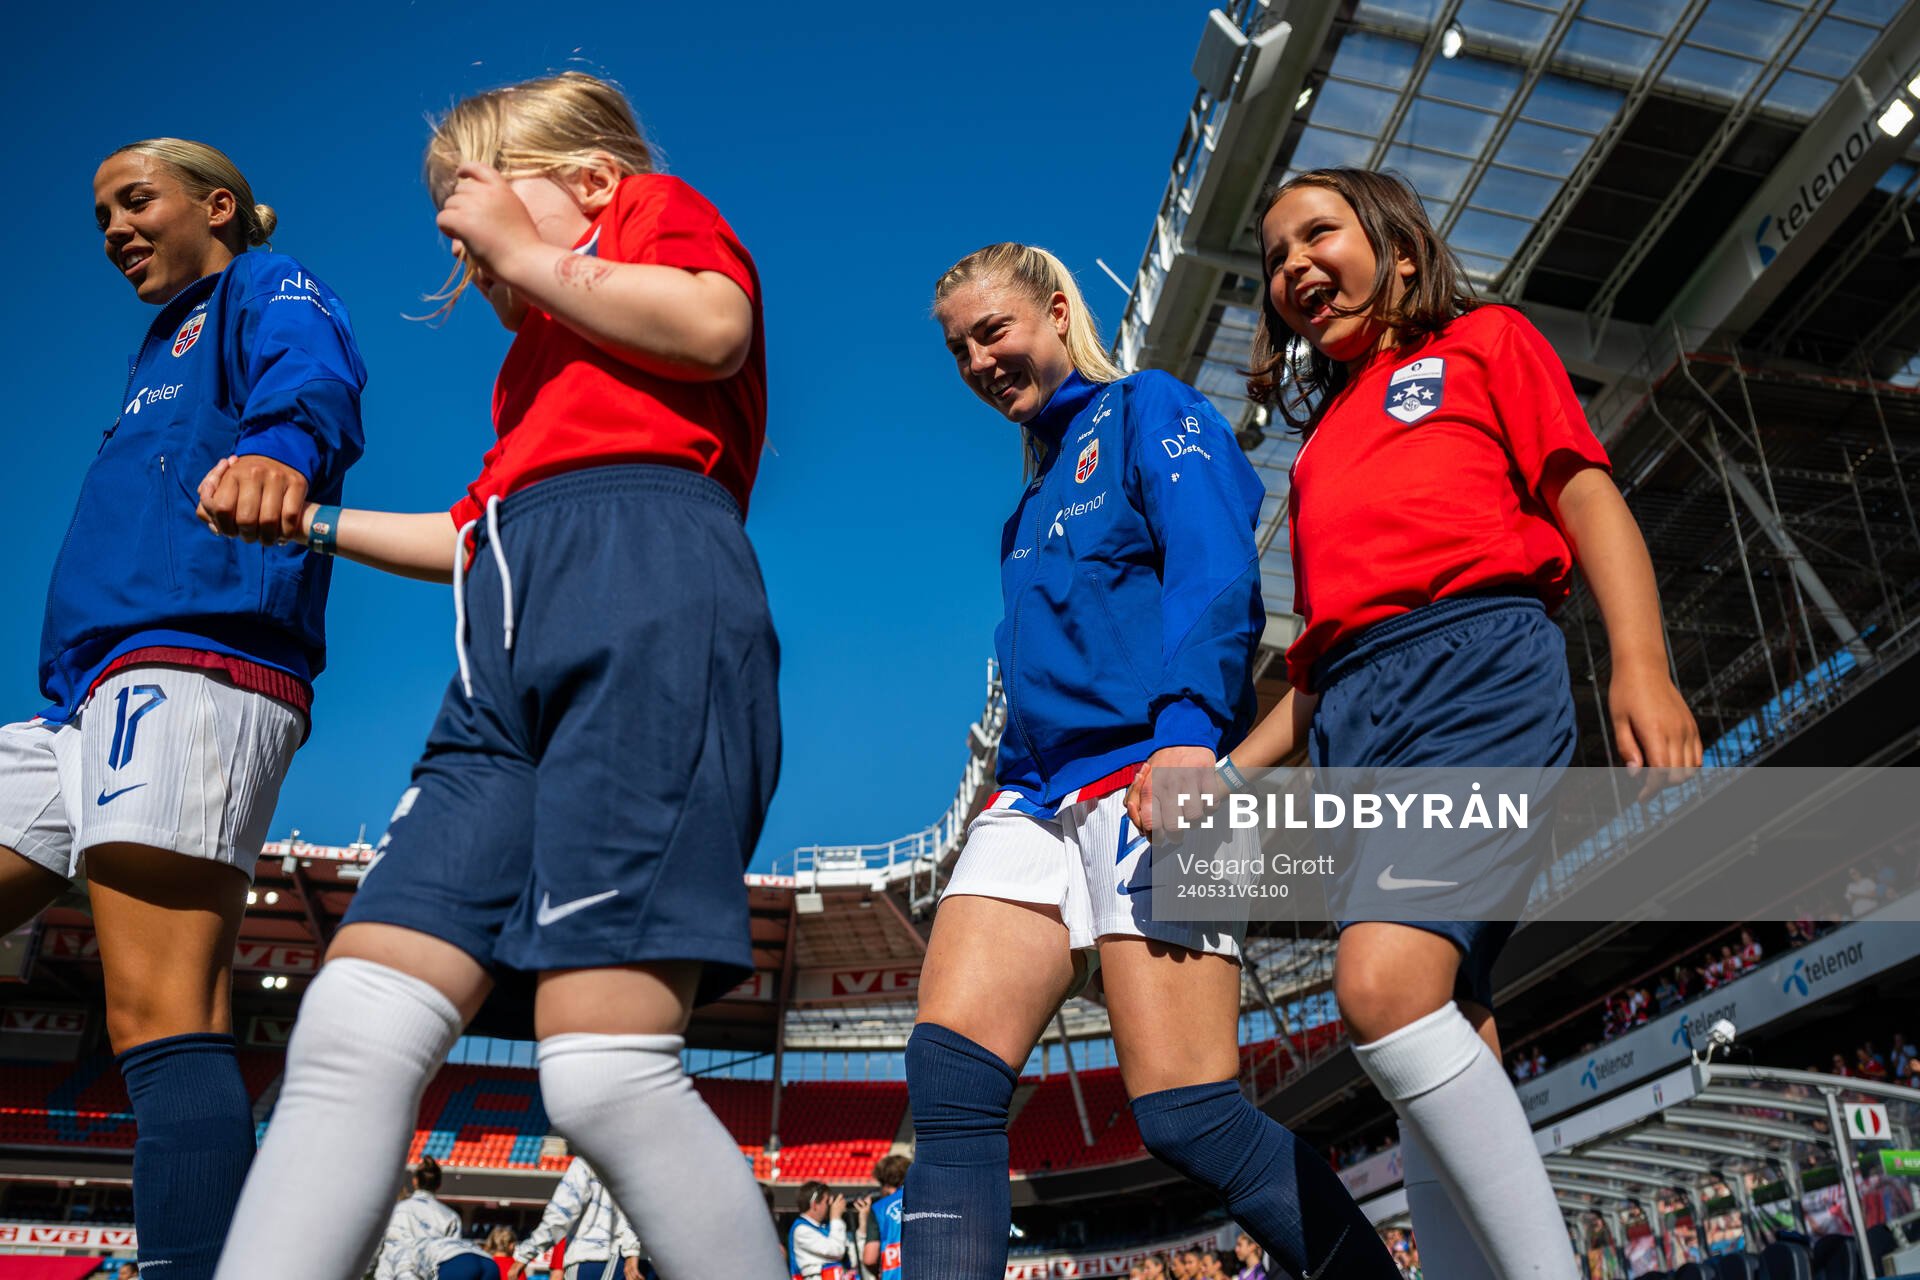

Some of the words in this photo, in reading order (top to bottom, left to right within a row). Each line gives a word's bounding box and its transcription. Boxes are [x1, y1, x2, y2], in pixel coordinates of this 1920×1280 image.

[1775, 121, 1873, 242] telenor
[1064, 491, 1107, 521] elenor
[108, 684, 168, 772] 17
[235, 943, 316, 970] VG
[1805, 941, 1864, 985] telenor
[834, 971, 920, 995] VG
[1595, 1050, 1634, 1081] telenor
[32, 1229, 88, 1243] VG
[1056, 1260, 1102, 1277] VG
